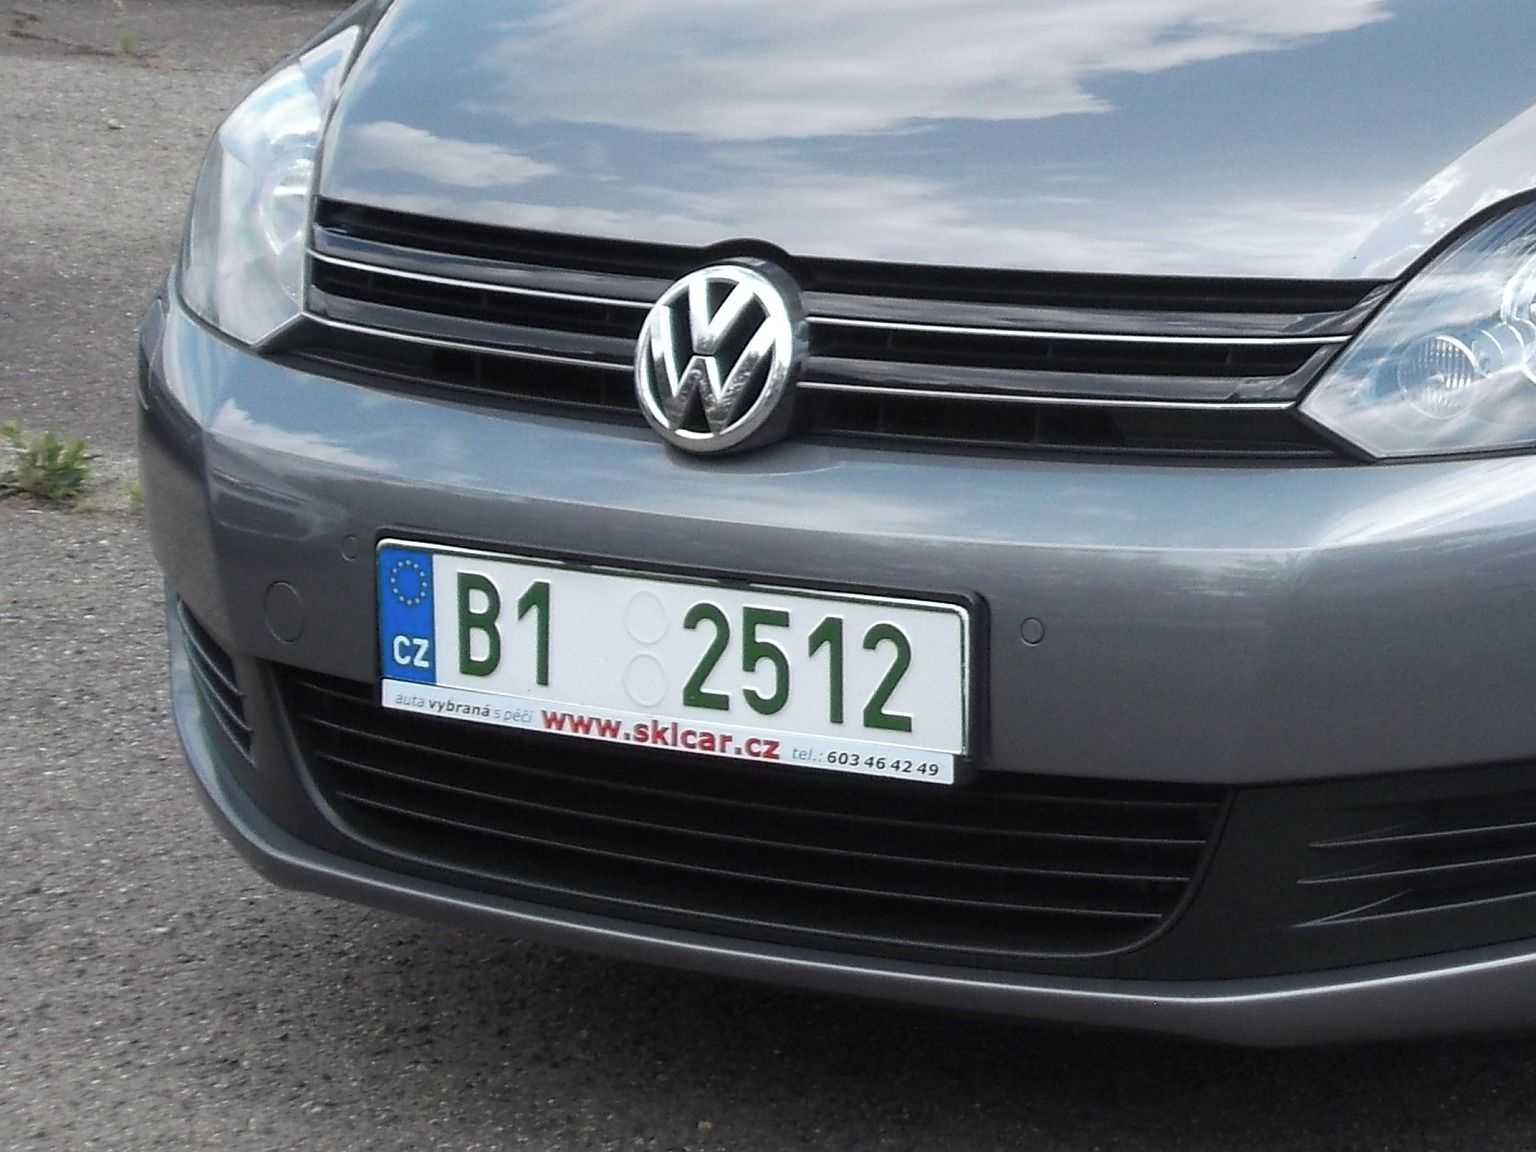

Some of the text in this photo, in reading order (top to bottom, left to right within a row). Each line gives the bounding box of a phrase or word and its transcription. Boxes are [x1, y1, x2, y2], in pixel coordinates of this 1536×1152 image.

[637, 266, 791, 451] VW
[393, 635, 430, 668] CZ
[457, 571, 912, 733] B1 2512
[395, 694, 425, 708] auta
[428, 698, 490, 718] vybraná
[827, 751, 860, 767] 603
[864, 756, 886, 770] 46
[890, 759, 912, 774] 42
[917, 762, 939, 777] 49
